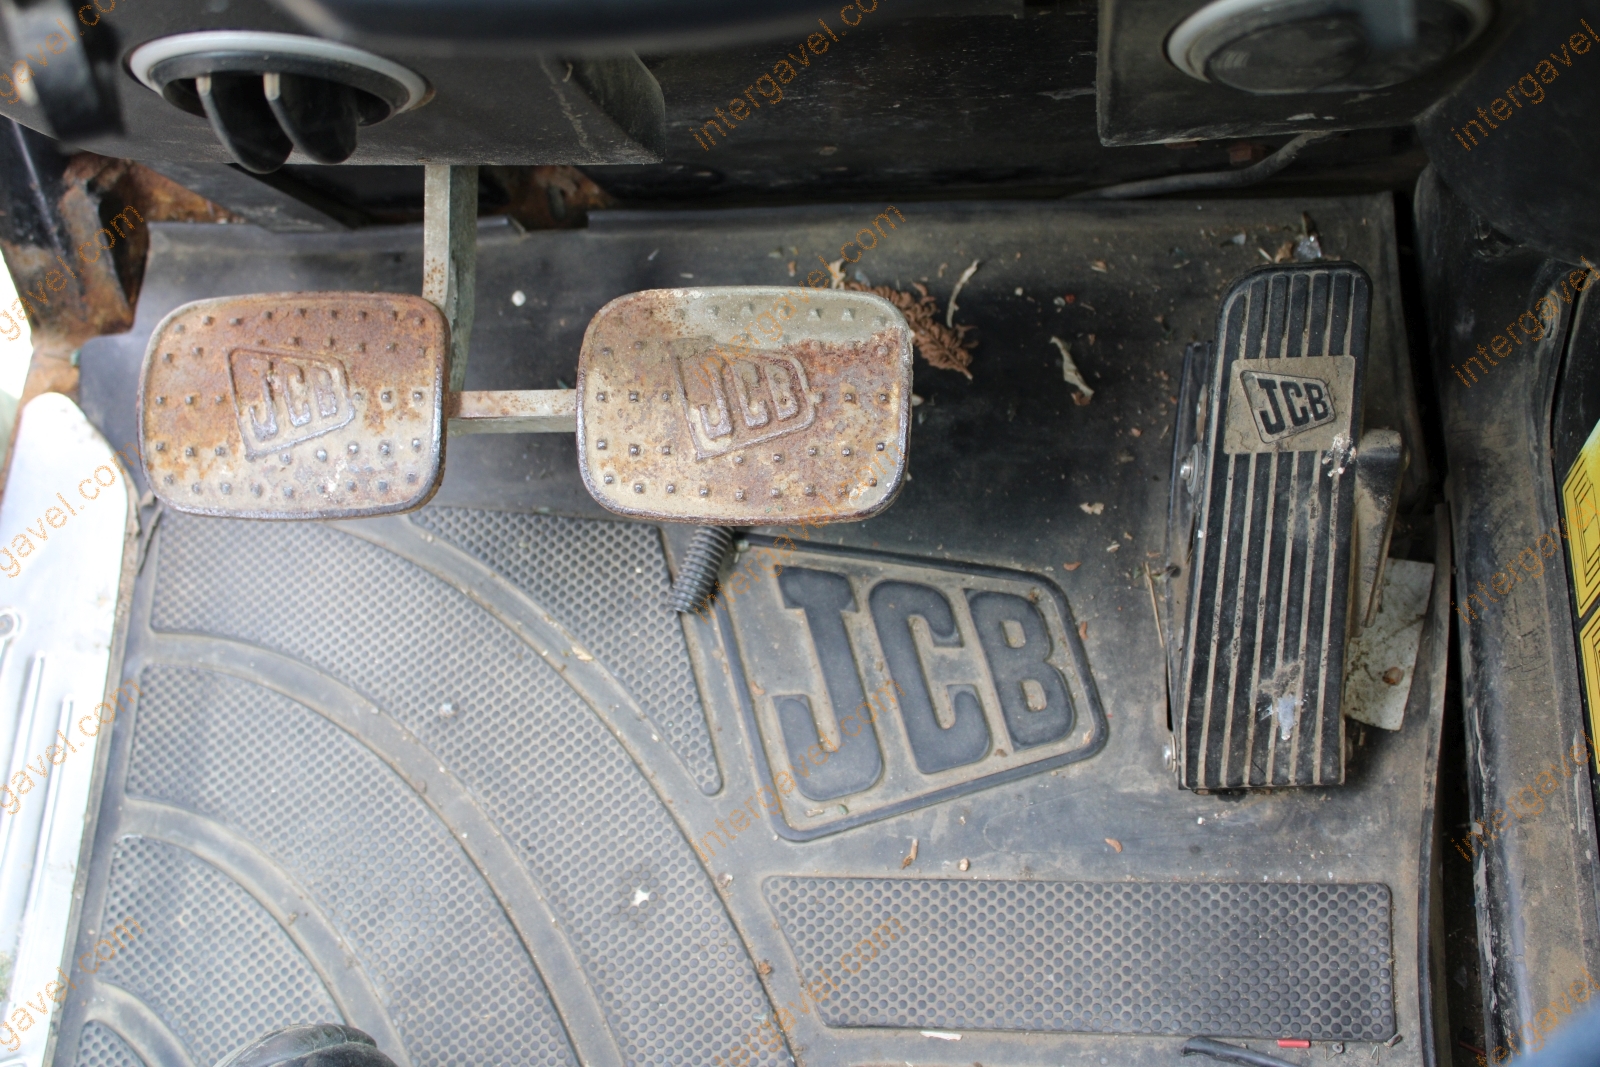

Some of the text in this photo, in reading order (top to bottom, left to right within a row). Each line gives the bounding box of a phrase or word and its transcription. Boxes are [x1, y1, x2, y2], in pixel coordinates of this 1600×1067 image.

[250, 356, 338, 442] JCB
[700, 353, 798, 440] JCB
[1256, 377, 1329, 435] JCB
[772, 566, 1077, 800] JCB
